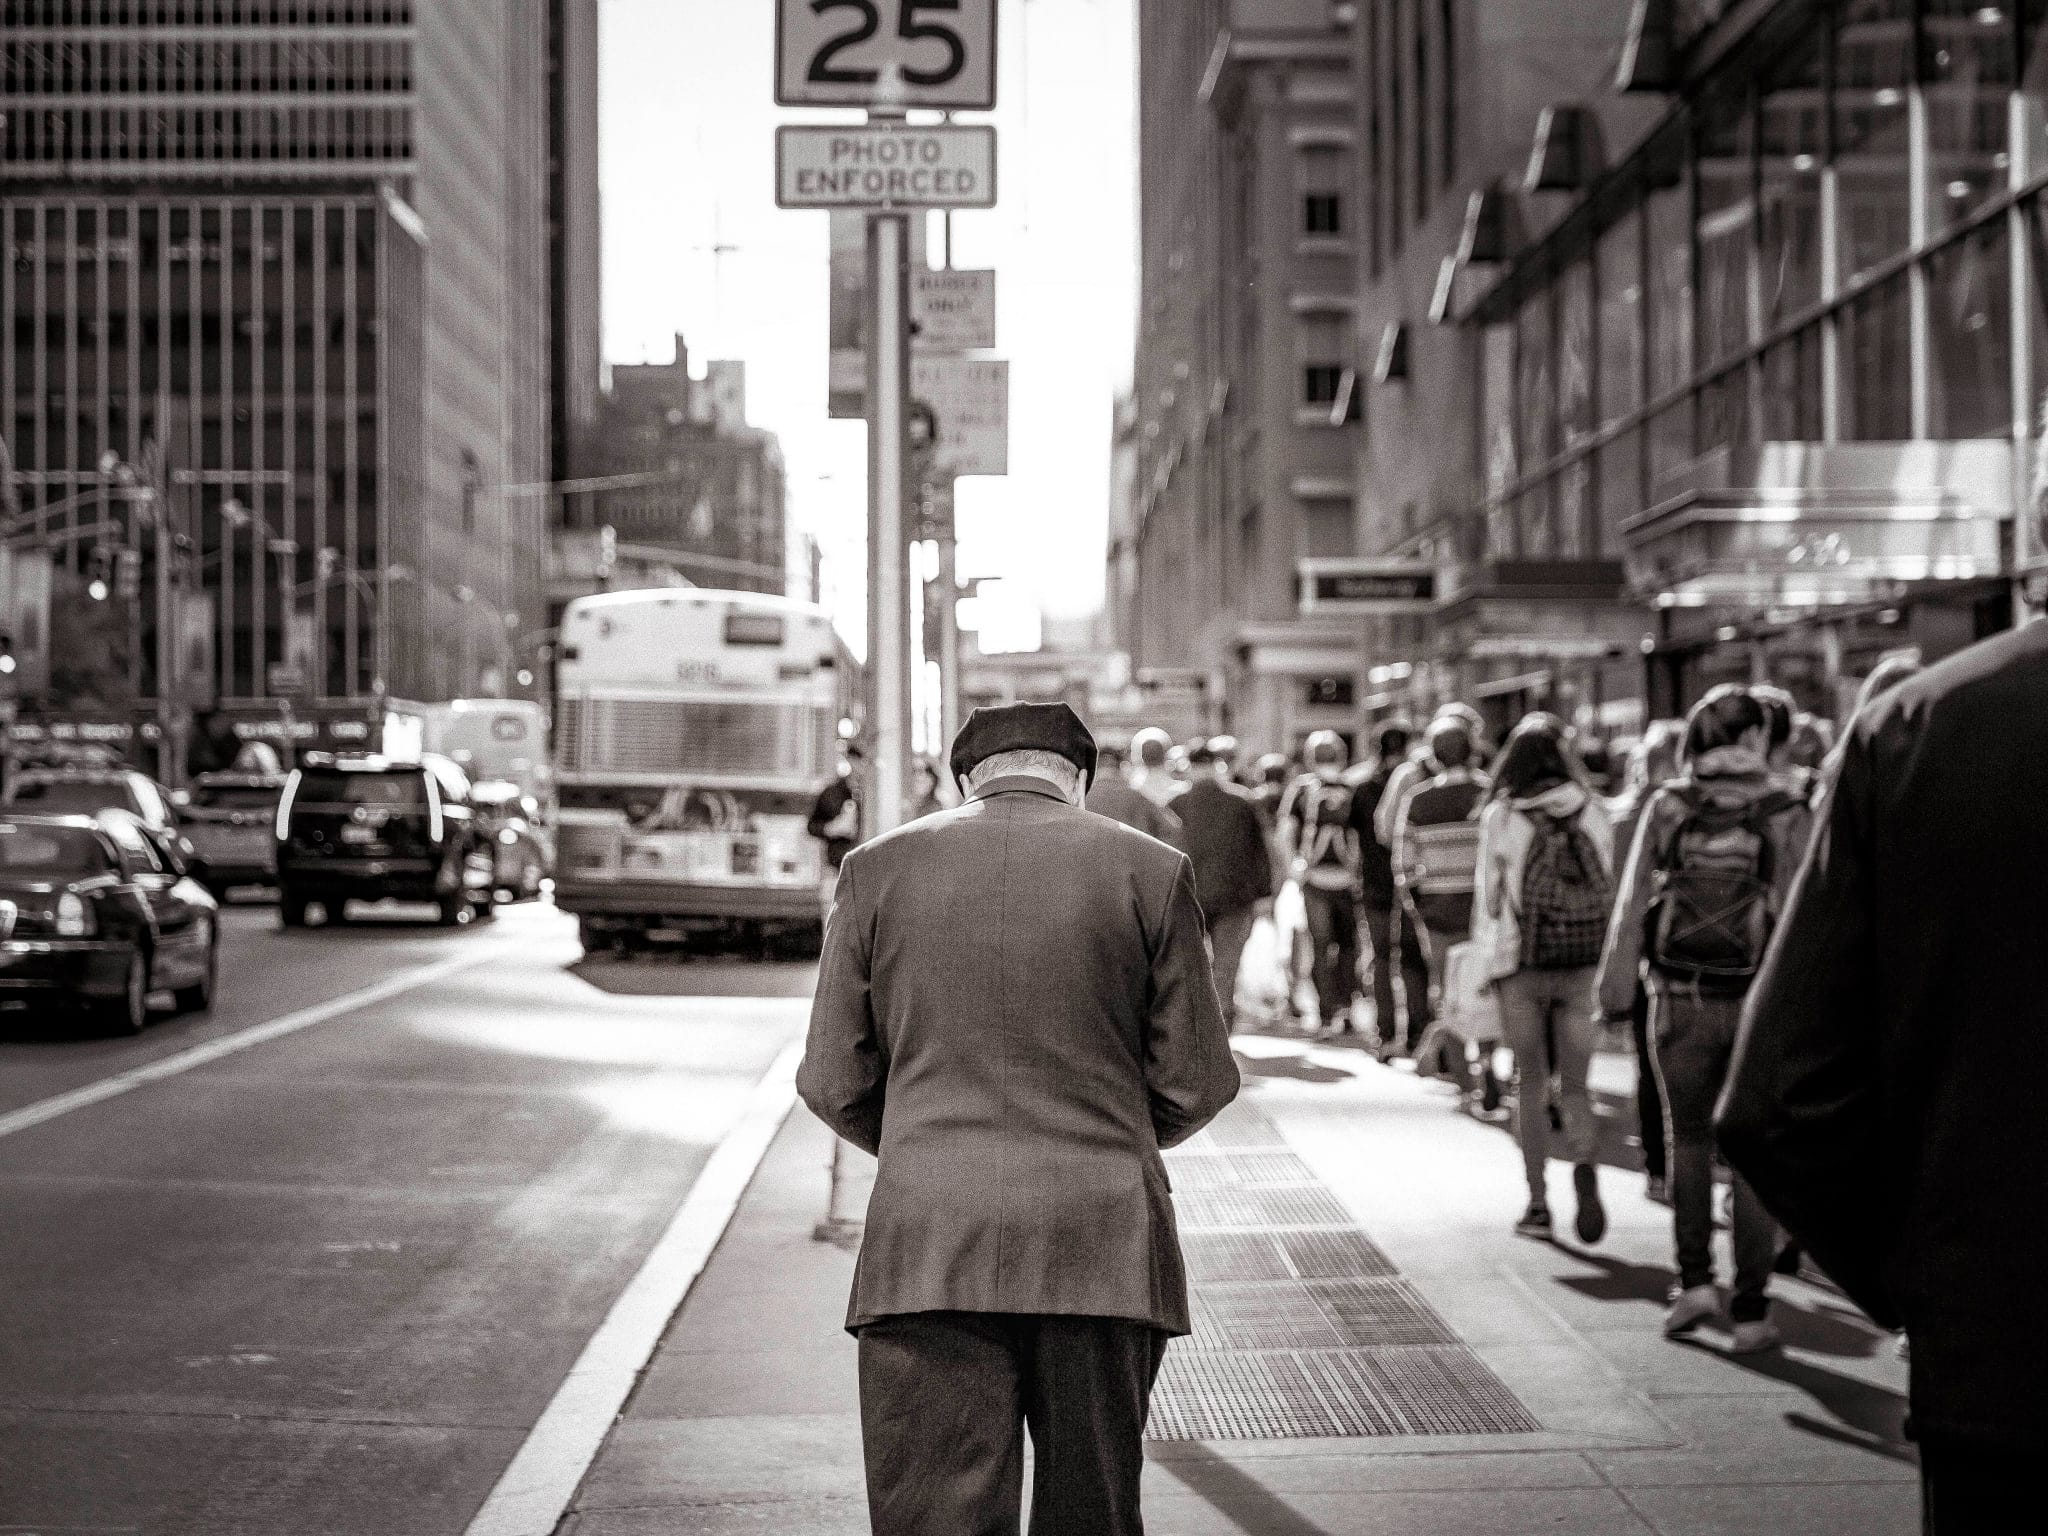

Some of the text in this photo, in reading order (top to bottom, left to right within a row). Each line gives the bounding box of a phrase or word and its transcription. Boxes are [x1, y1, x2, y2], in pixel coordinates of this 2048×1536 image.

[807, 0, 965, 85] 25
[830, 138, 943, 164] PHOTO
[797, 168, 977, 194] ENFORCED
